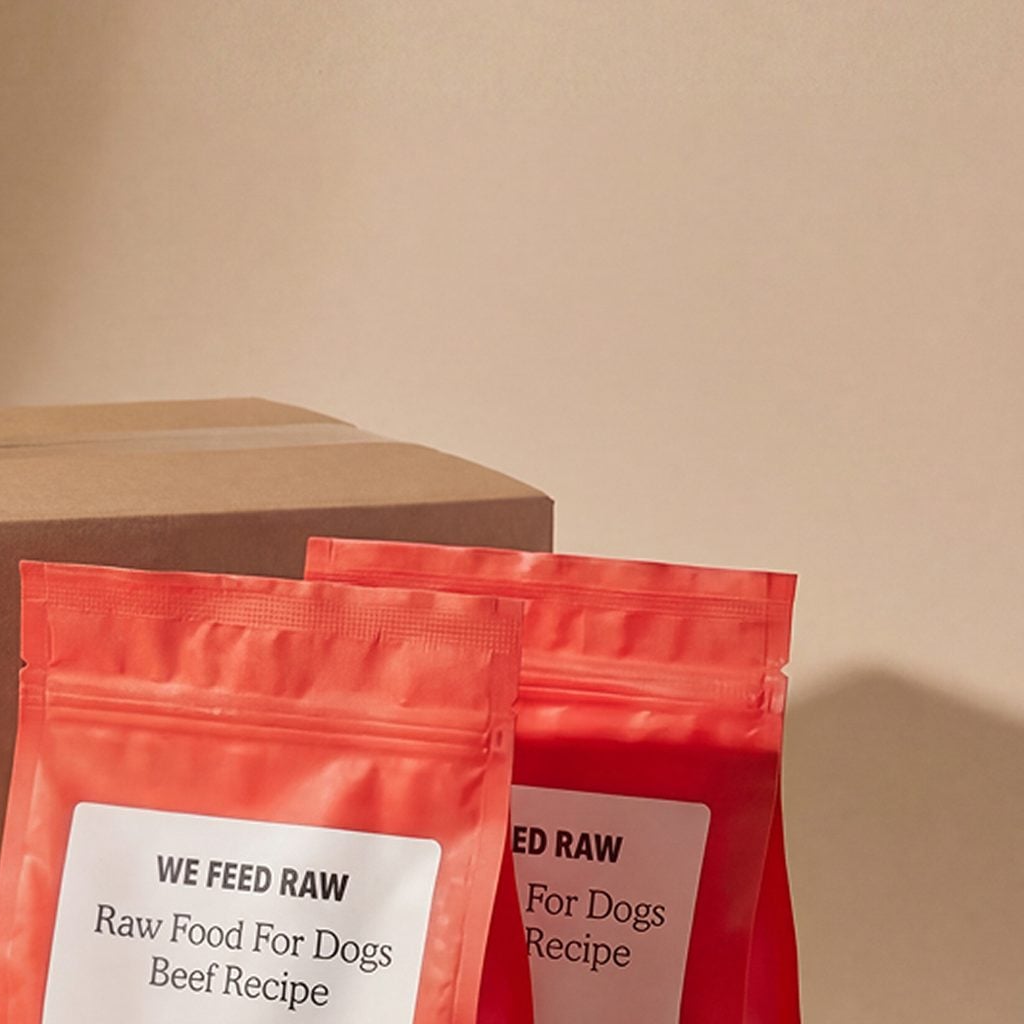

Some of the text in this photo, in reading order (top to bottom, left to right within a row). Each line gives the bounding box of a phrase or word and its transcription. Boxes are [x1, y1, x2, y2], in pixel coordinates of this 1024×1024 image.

[555, 830, 624, 863] RAW
[156, 855, 350, 902] WE FEED RAW
[526, 883, 666, 933] For Dogs
[94, 903, 393, 973] Raw Food For Dogs
[526, 927, 631, 972] Recipe
[149, 956, 329, 1011] Beef Recipe
